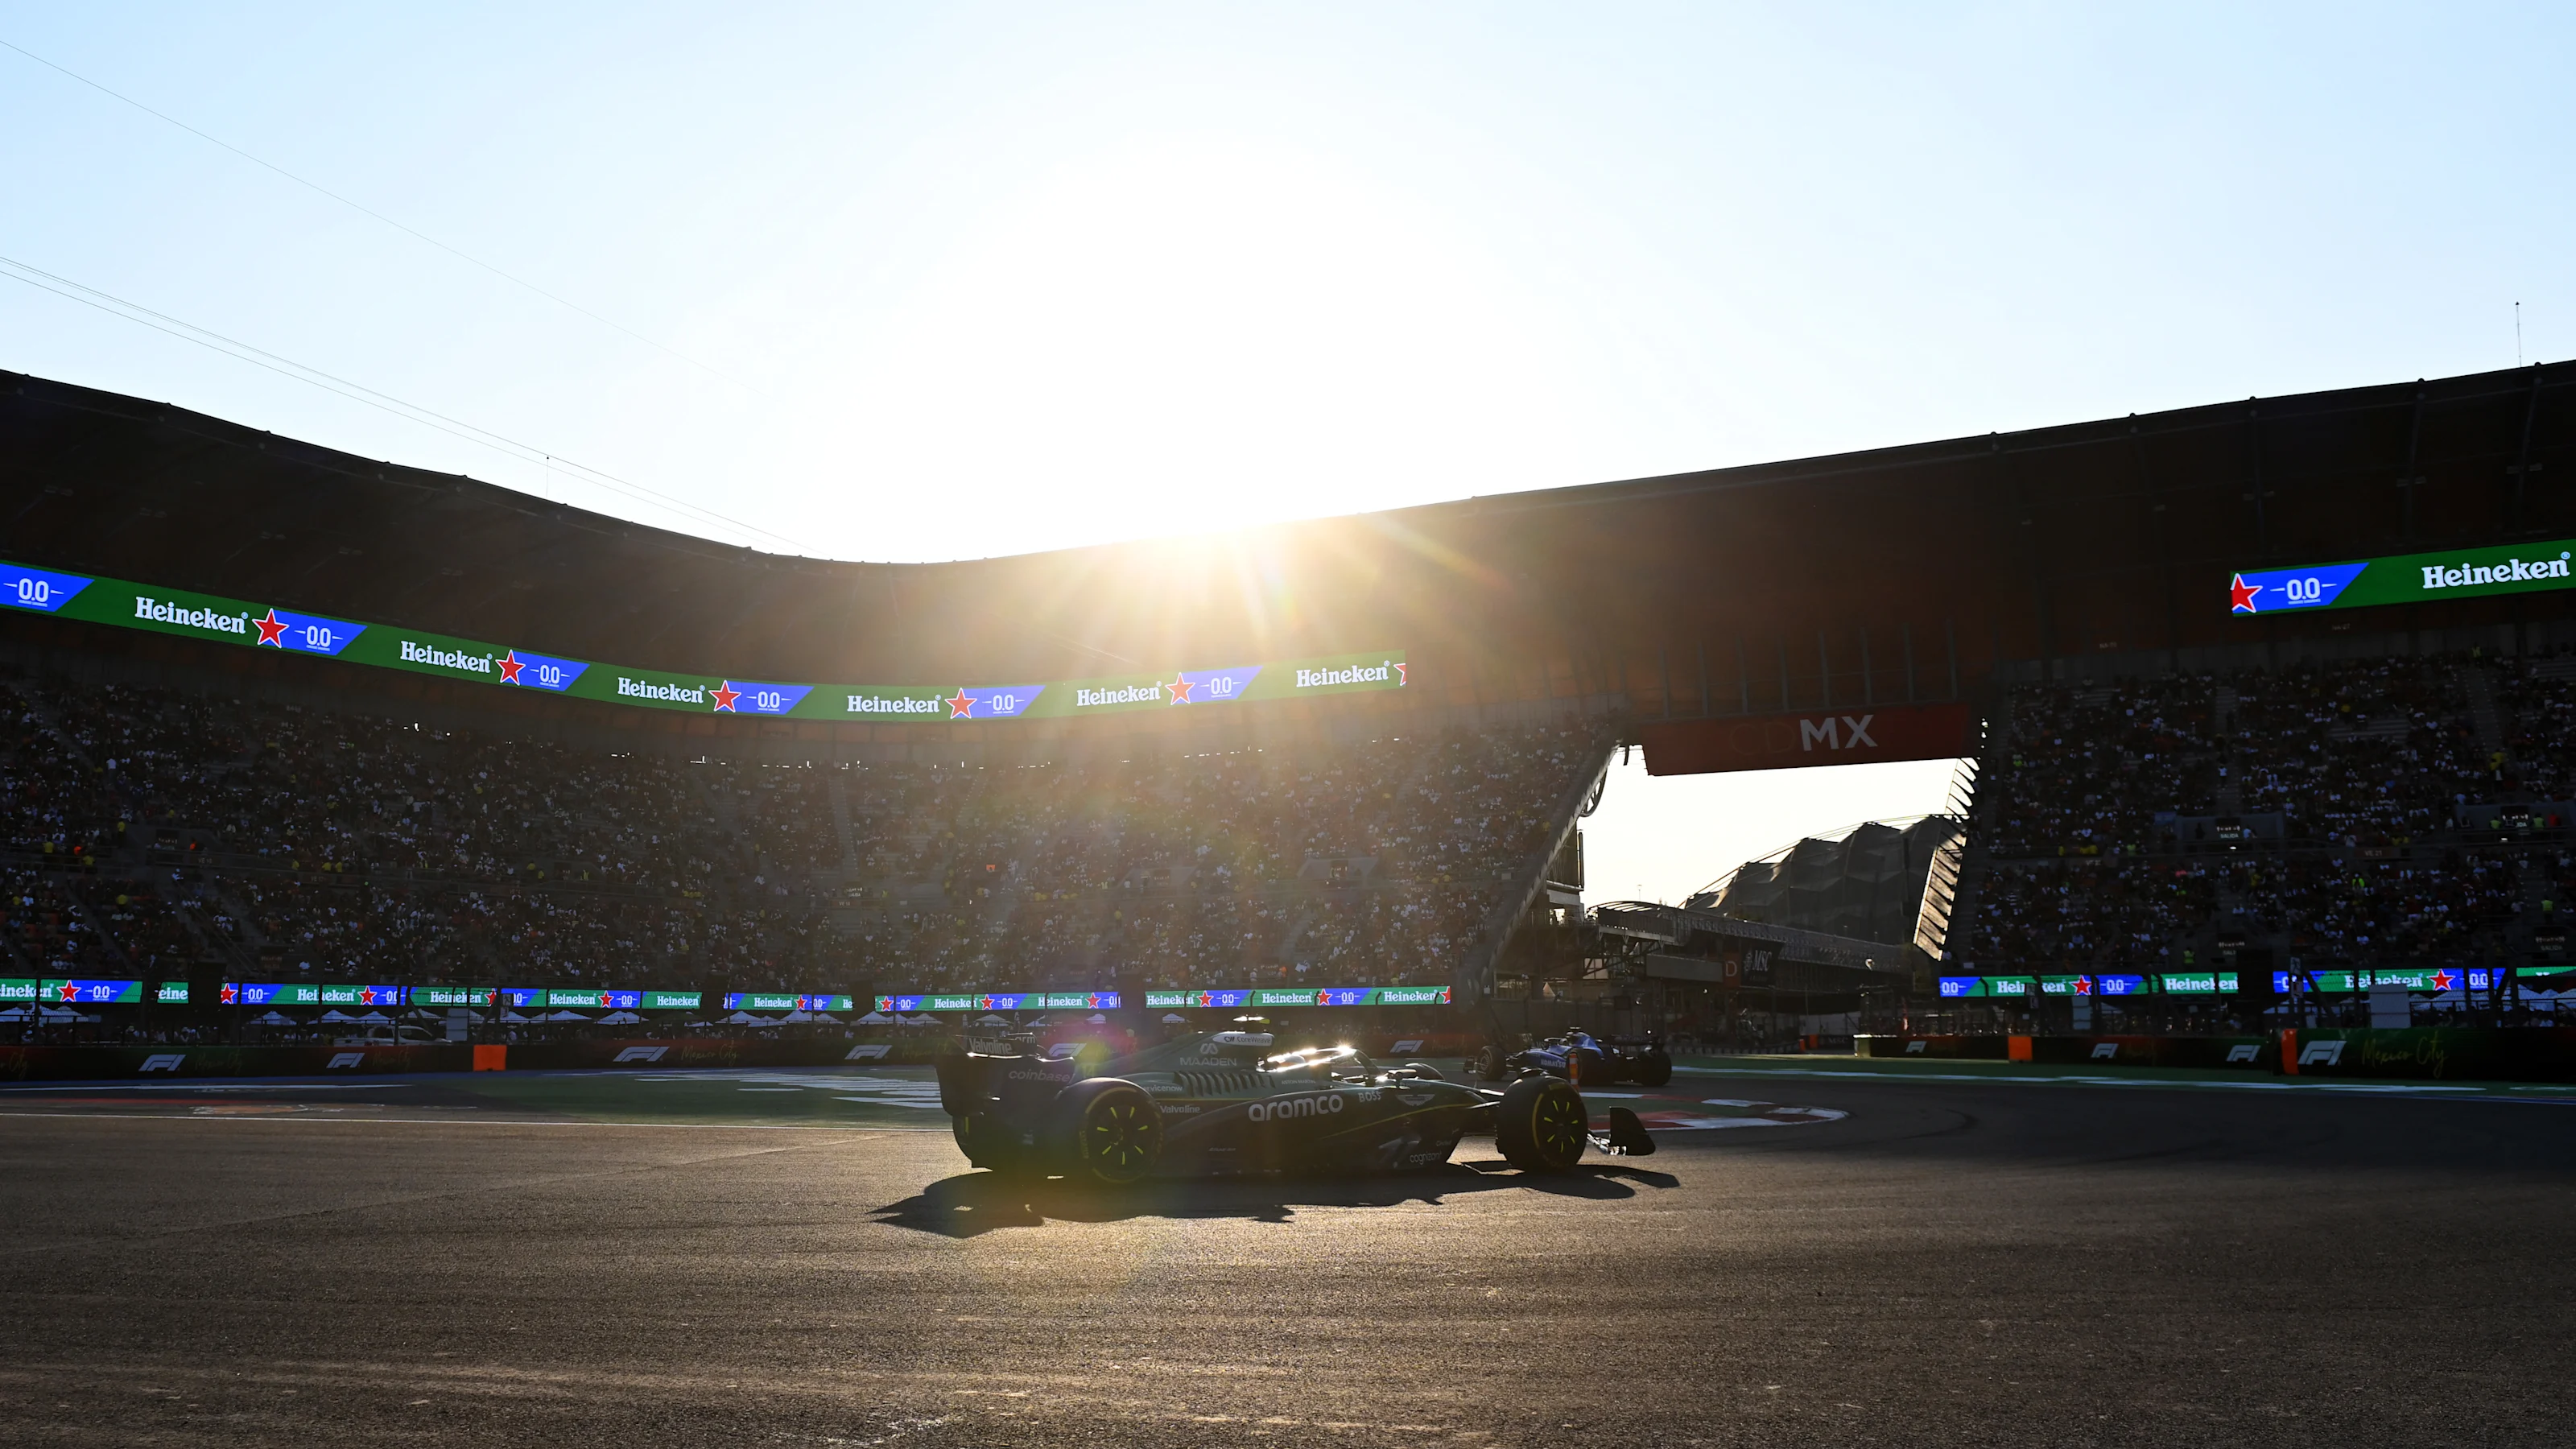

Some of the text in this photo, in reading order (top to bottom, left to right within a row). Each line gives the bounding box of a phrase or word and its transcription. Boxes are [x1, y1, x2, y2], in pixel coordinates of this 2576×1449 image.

[19, 578, 49, 602] 0.0
[2287, 577, 2321, 601] 0.0
[306, 625, 329, 647] 0.0
[539, 664, 559, 683] 0.0
[1211, 676, 1232, 695] 0.0
[758, 691, 779, 708] 0.0
[993, 694, 1013, 712] 0.0
[1725, 960, 1738, 976] D
[1752, 950, 1773, 972] MSC
[968, 1038, 1012, 1055] Valvoline
[1236, 1036, 1271, 1044] CoreWeave
[1180, 1057, 1237, 1066] MAADEN
[1541, 1059, 1567, 1068] KOMATSU
[2362, 1038, 2413, 1069] Mexico
[2416, 1030, 2449, 1080] City
[1009, 1068, 1071, 1082] coinbase
[1358, 1091, 1381, 1103] BOSS
[1159, 1104, 1200, 1113] Valvoline
[1249, 1094, 1344, 1121] aramco
